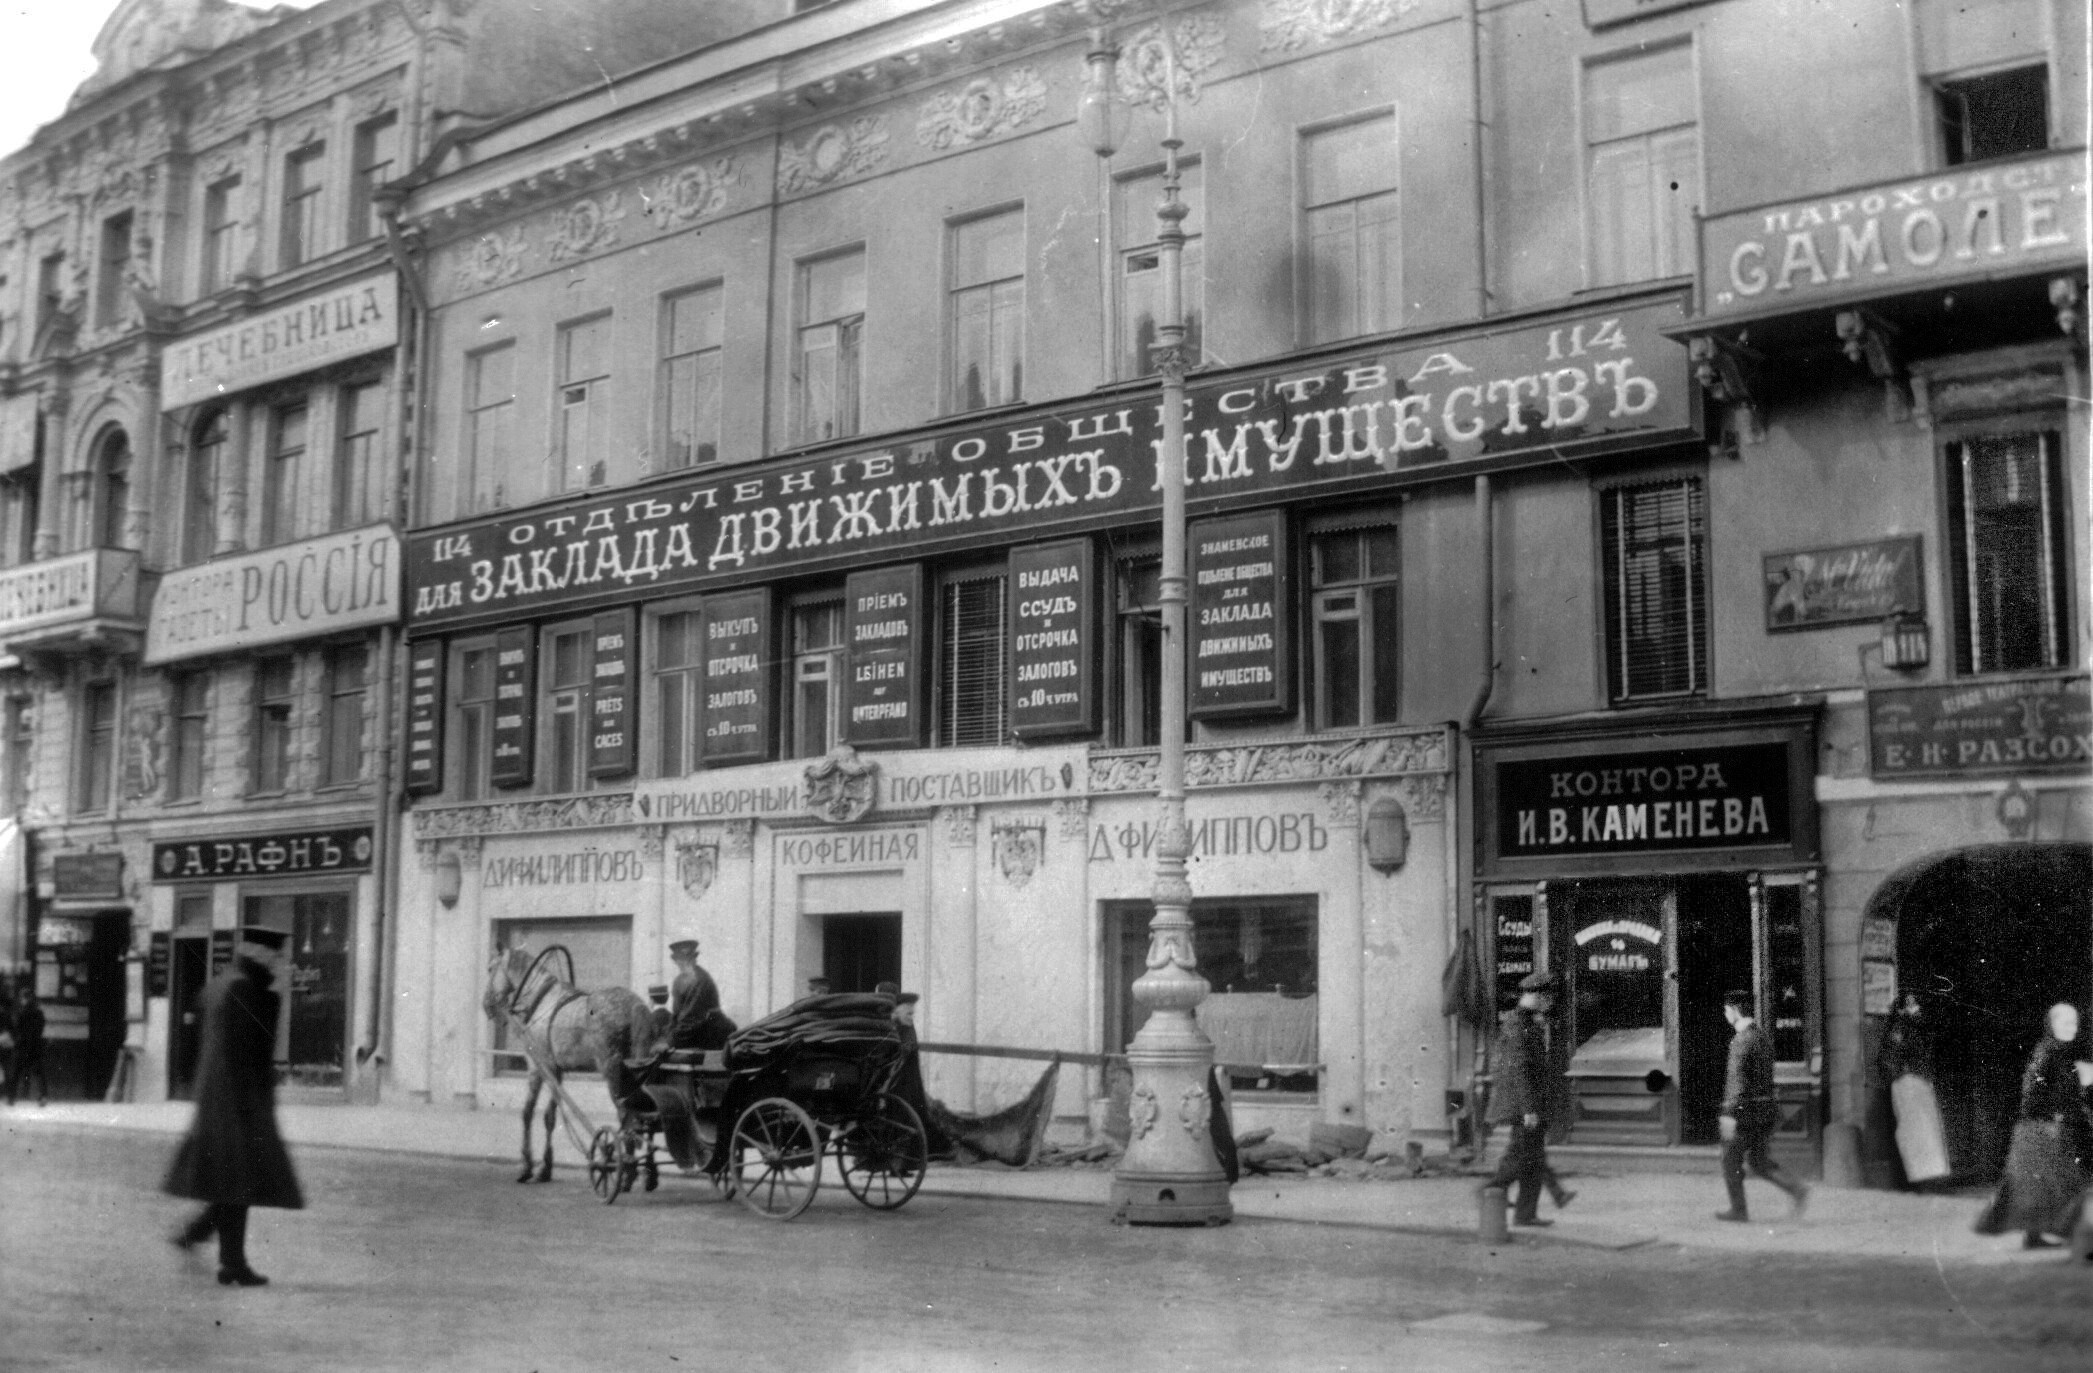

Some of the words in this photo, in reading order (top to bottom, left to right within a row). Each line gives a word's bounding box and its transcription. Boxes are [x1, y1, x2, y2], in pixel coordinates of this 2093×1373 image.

[1545, 318, 1628, 361] 114
[414, 580, 464, 616] ДЛЯ
[469, 522, 699, 603] ЗАКЛАДА
[708, 448, 1123, 572] ДВИЖИМЫХЪ
[1201, 534, 1270, 556] ЗНАМЕНСКОЕ
[1019, 565, 1079, 589] ВЫДАЧА
[858, 592, 908, 613] ПРІЕМЪ
[1020, 596, 1078, 618] ССУДЪ
[1201, 602, 1273, 625] ЗАКЛАДА
[1016, 628, 1079, 652] ОТСРОЧКА
[1198, 633, 1274, 658] ДВИЖИМЫХЪ
[1017, 659, 1078, 682] ЗАЛОГОВЪ
[1201, 666, 1273, 688] ИМУЩЕСТВЪ
[1031, 688, 1046, 707] 10
[1550, 763, 1728, 798] КОНТОРА
